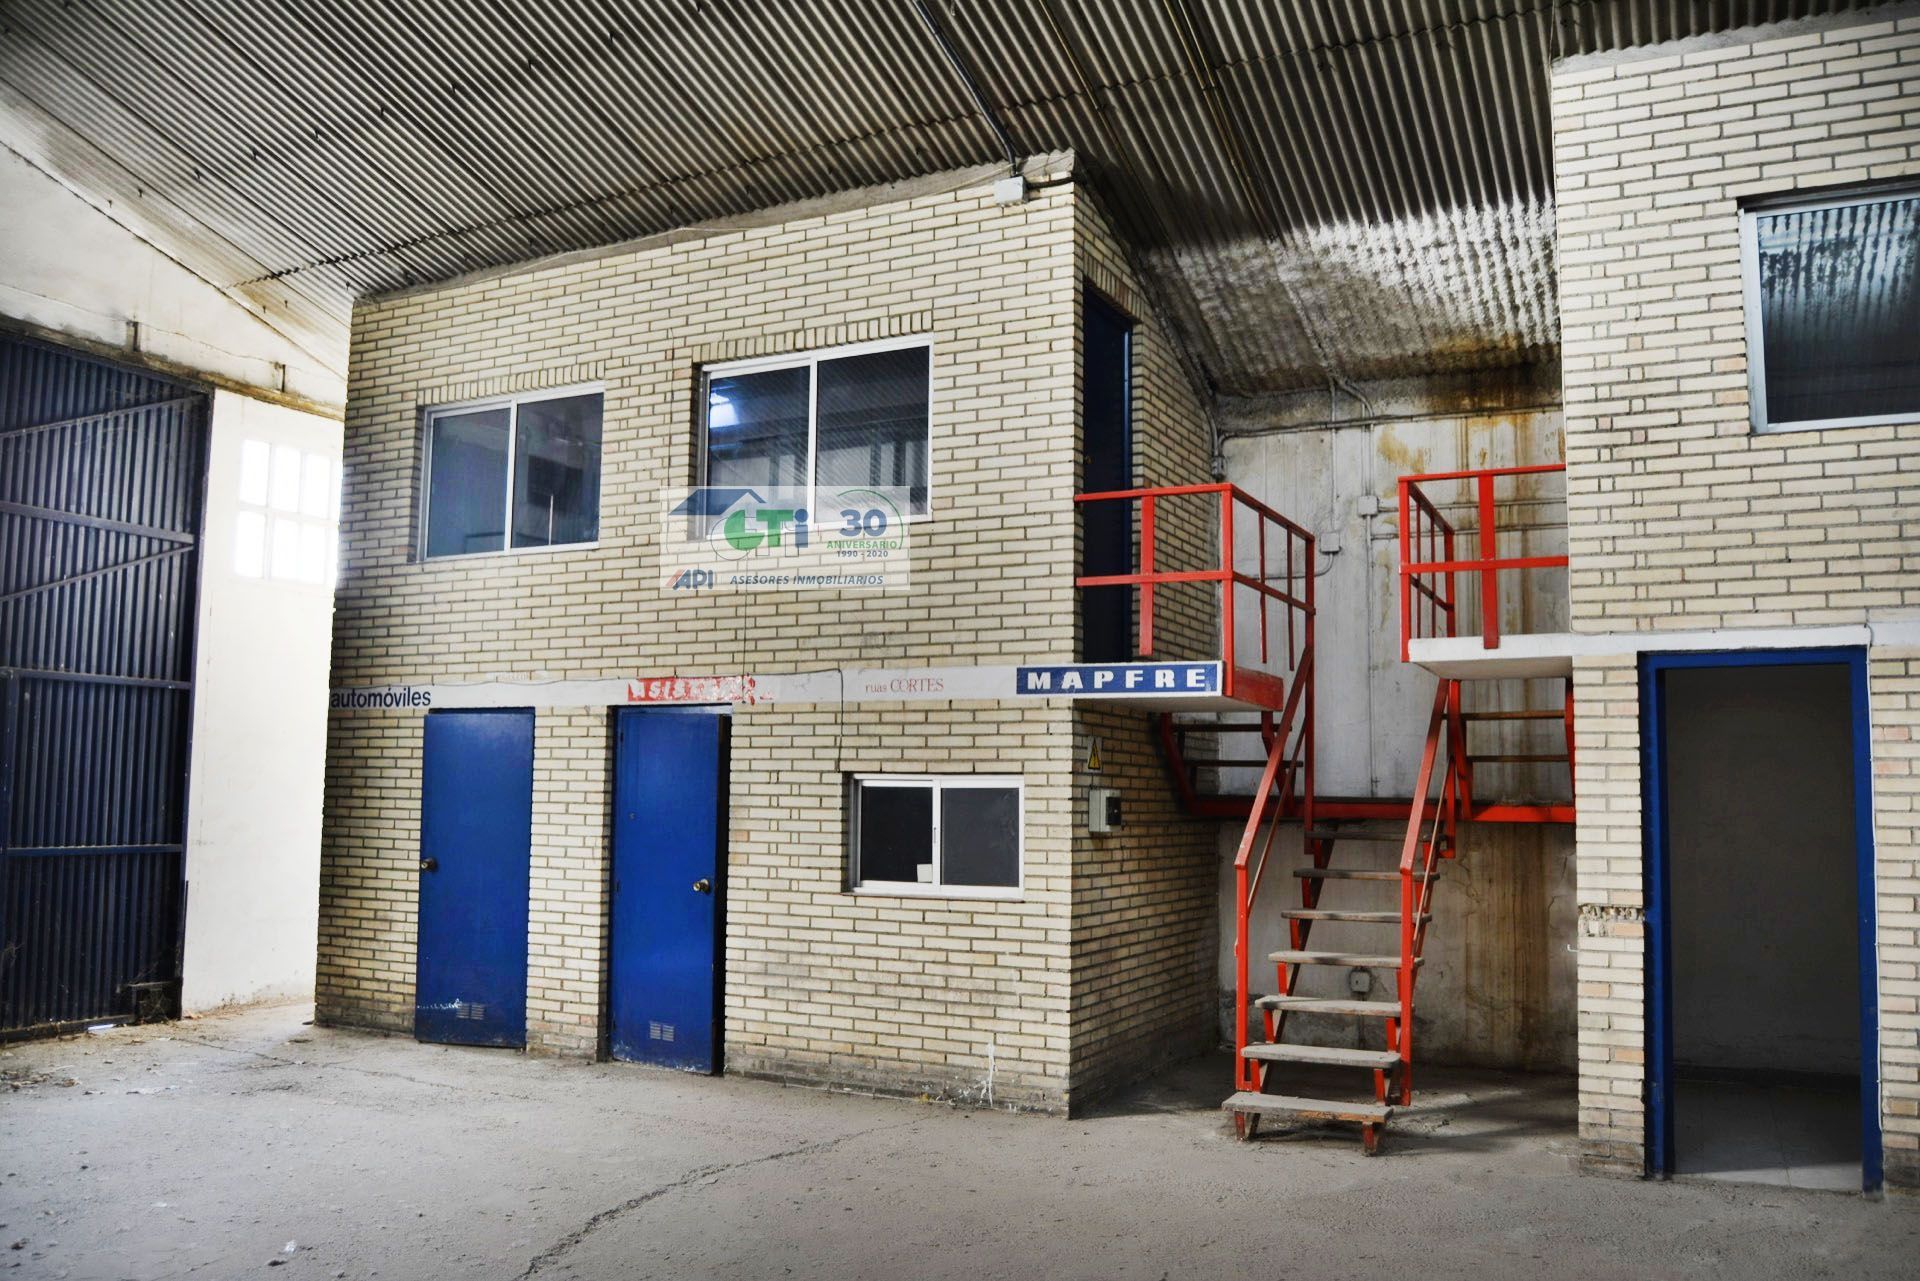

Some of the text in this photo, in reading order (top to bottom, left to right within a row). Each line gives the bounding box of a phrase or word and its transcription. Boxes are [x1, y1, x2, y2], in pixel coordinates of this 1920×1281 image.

[890, 677, 945, 693] CORTES
[1026, 668, 1206, 690] MAPFRE
[330, 686, 432, 708] automóviles
